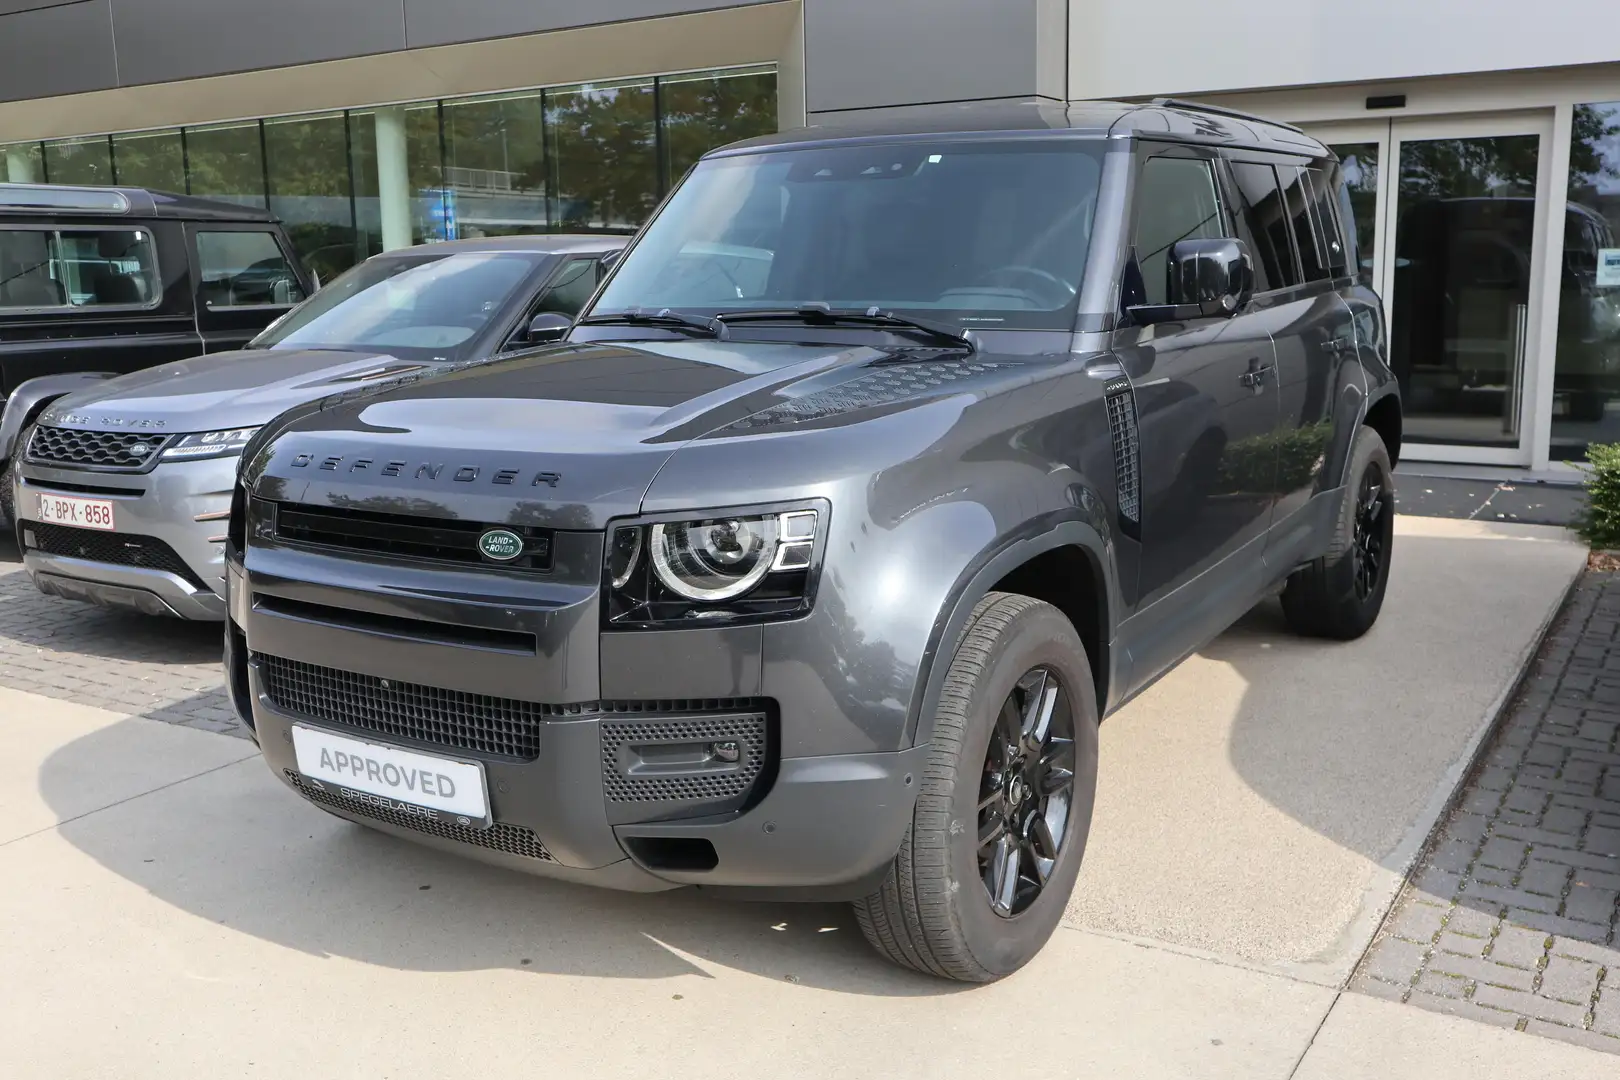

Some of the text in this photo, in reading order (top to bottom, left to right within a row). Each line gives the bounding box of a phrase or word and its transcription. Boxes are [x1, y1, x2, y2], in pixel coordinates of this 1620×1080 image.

[290, 453, 563, 488] DEFENDER
[320, 747, 456, 799] APPROVED
[340, 787, 438, 820] SPEGELAERE
